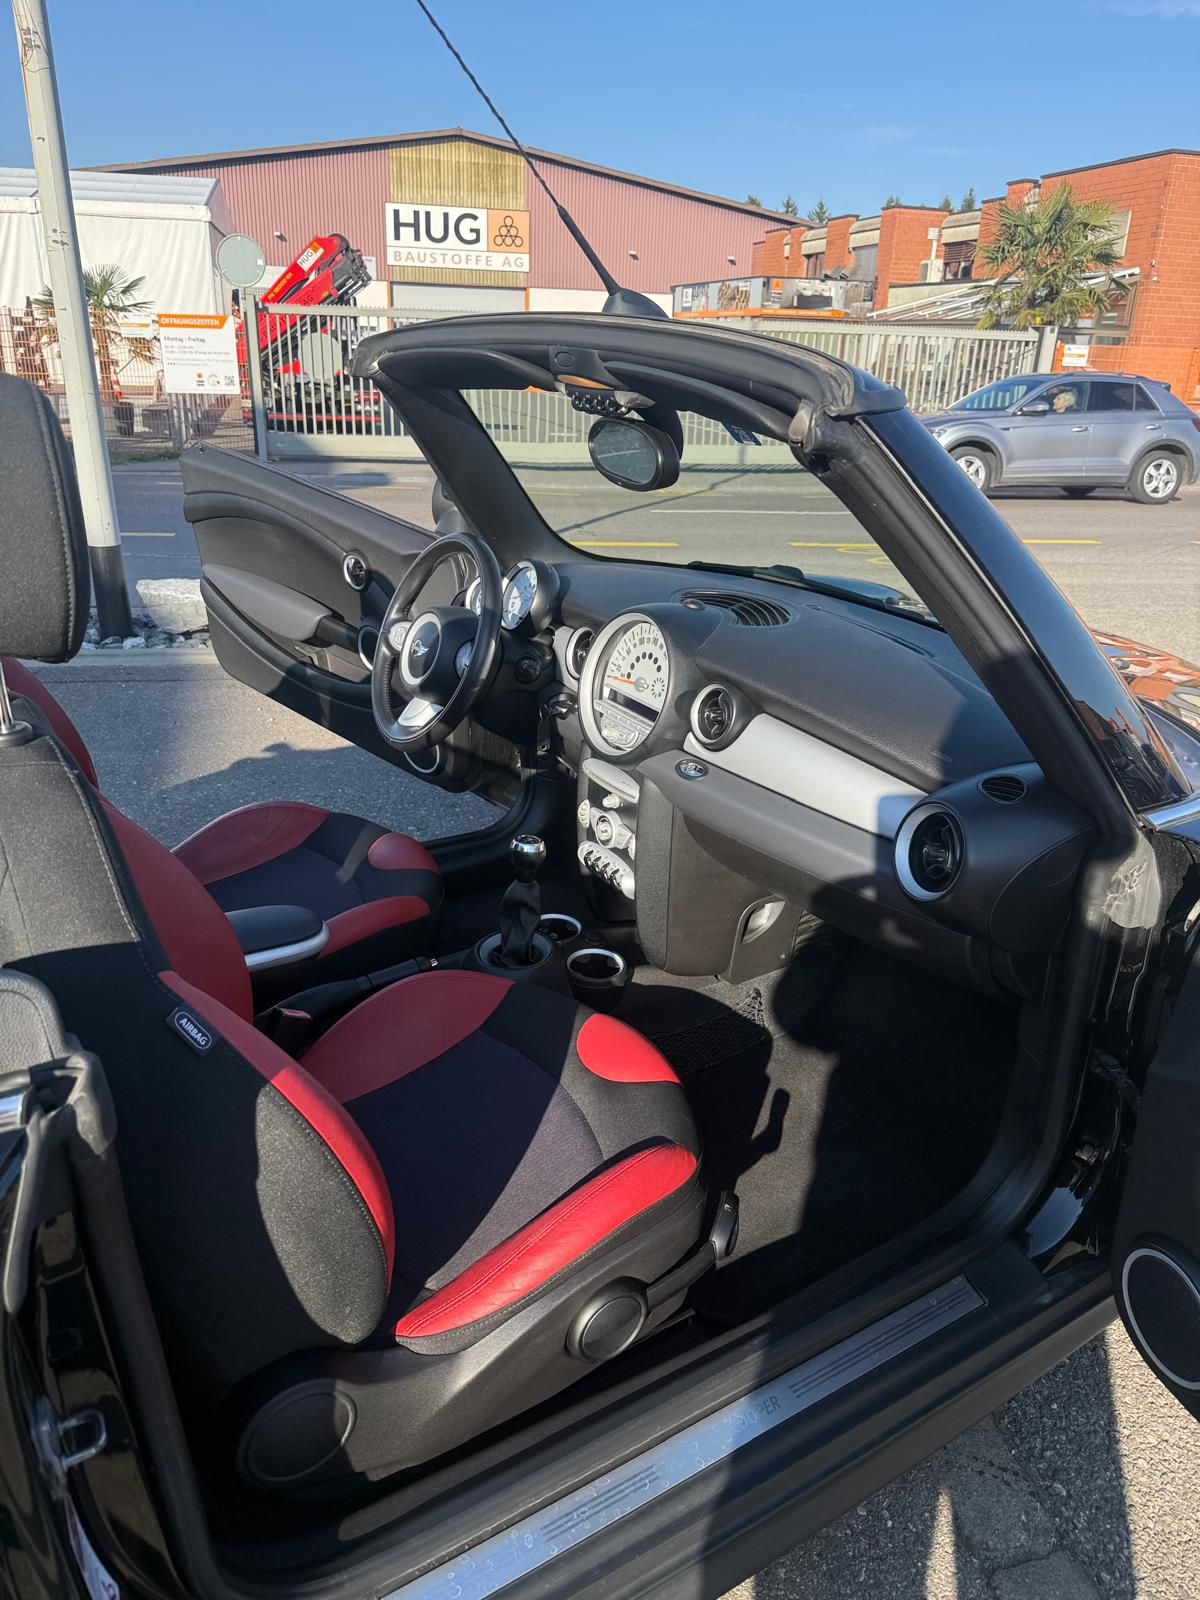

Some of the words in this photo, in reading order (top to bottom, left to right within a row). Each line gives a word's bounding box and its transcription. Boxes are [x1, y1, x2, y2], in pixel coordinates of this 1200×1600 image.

[393, 208, 481, 245] HUG
[298, 250, 314, 266] HUG
[393, 250, 493, 267] BAUSTOFFE
[502, 256, 524, 268] AG
[179, 1018, 208, 1045] AIRBAG
